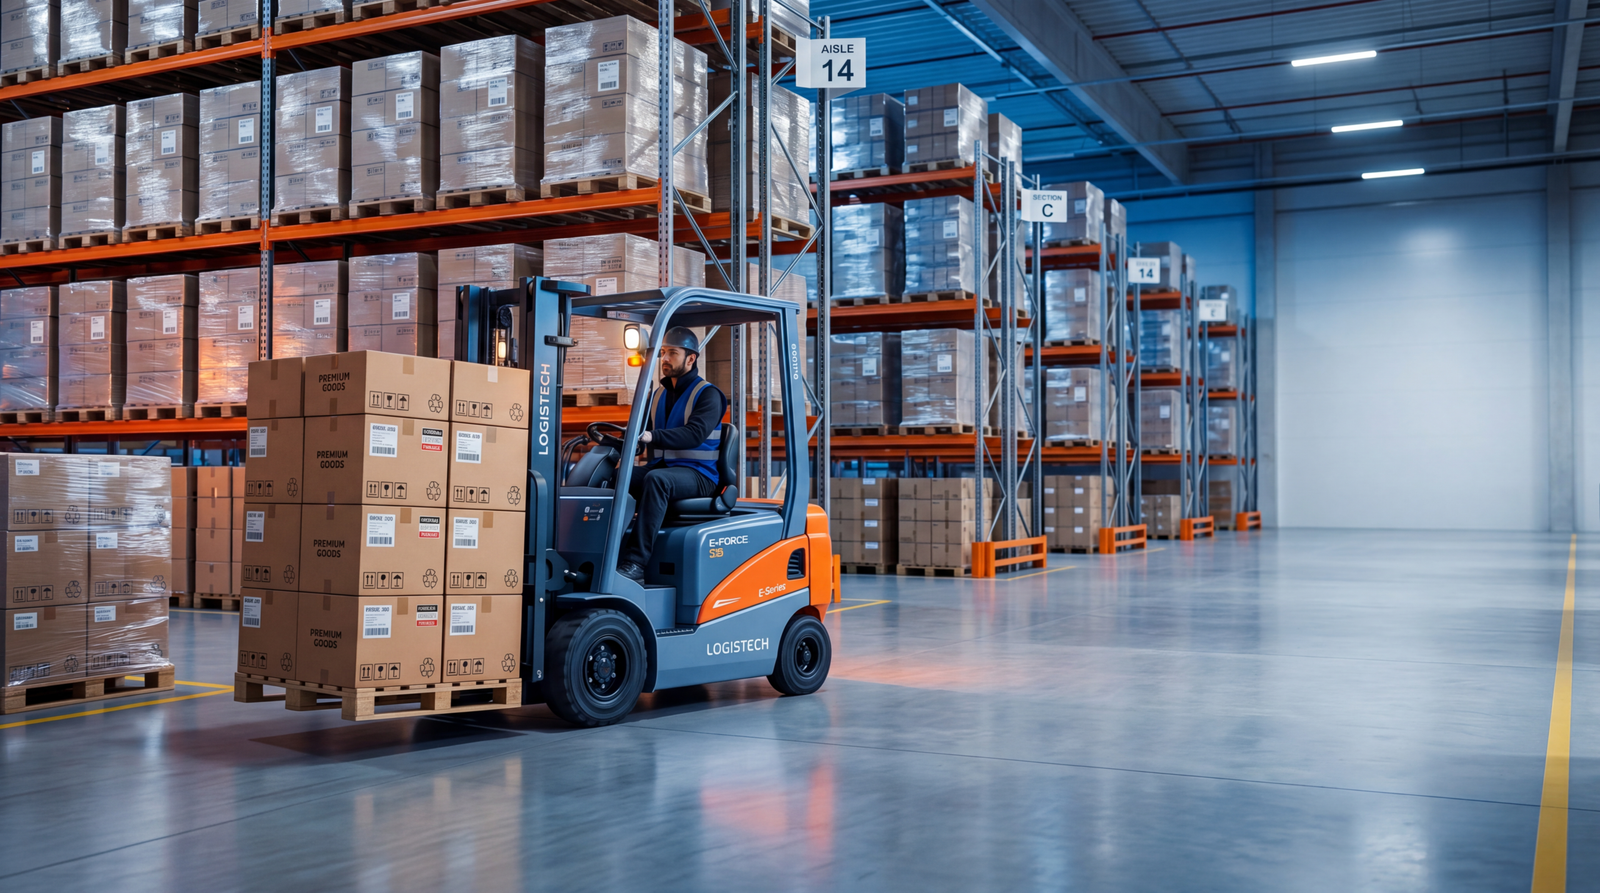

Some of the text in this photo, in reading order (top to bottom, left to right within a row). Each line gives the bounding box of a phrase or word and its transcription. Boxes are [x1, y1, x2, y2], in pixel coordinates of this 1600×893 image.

[821, 44, 854, 54] AISLE
[822, 58, 854, 82] 14
[1042, 203, 1053, 217] C
[1139, 268, 1154, 278] 14
[318, 372, 350, 383] PREMIUM
[322, 382, 346, 392] GOODS
[538, 363, 551, 455] LOGISTECH
[316, 450, 348, 459] PREMIUM
[320, 460, 345, 469] GOODS
[313, 539, 345, 548] PREMIUM
[709, 535, 749, 547] E-FORCE
[316, 549, 341, 558] GOODS
[758, 583, 787, 598] E-Series
[310, 628, 342, 639] PREMIUM
[313, 638, 338, 649] GOODS
[706, 637, 770, 656] LOGISTECH
